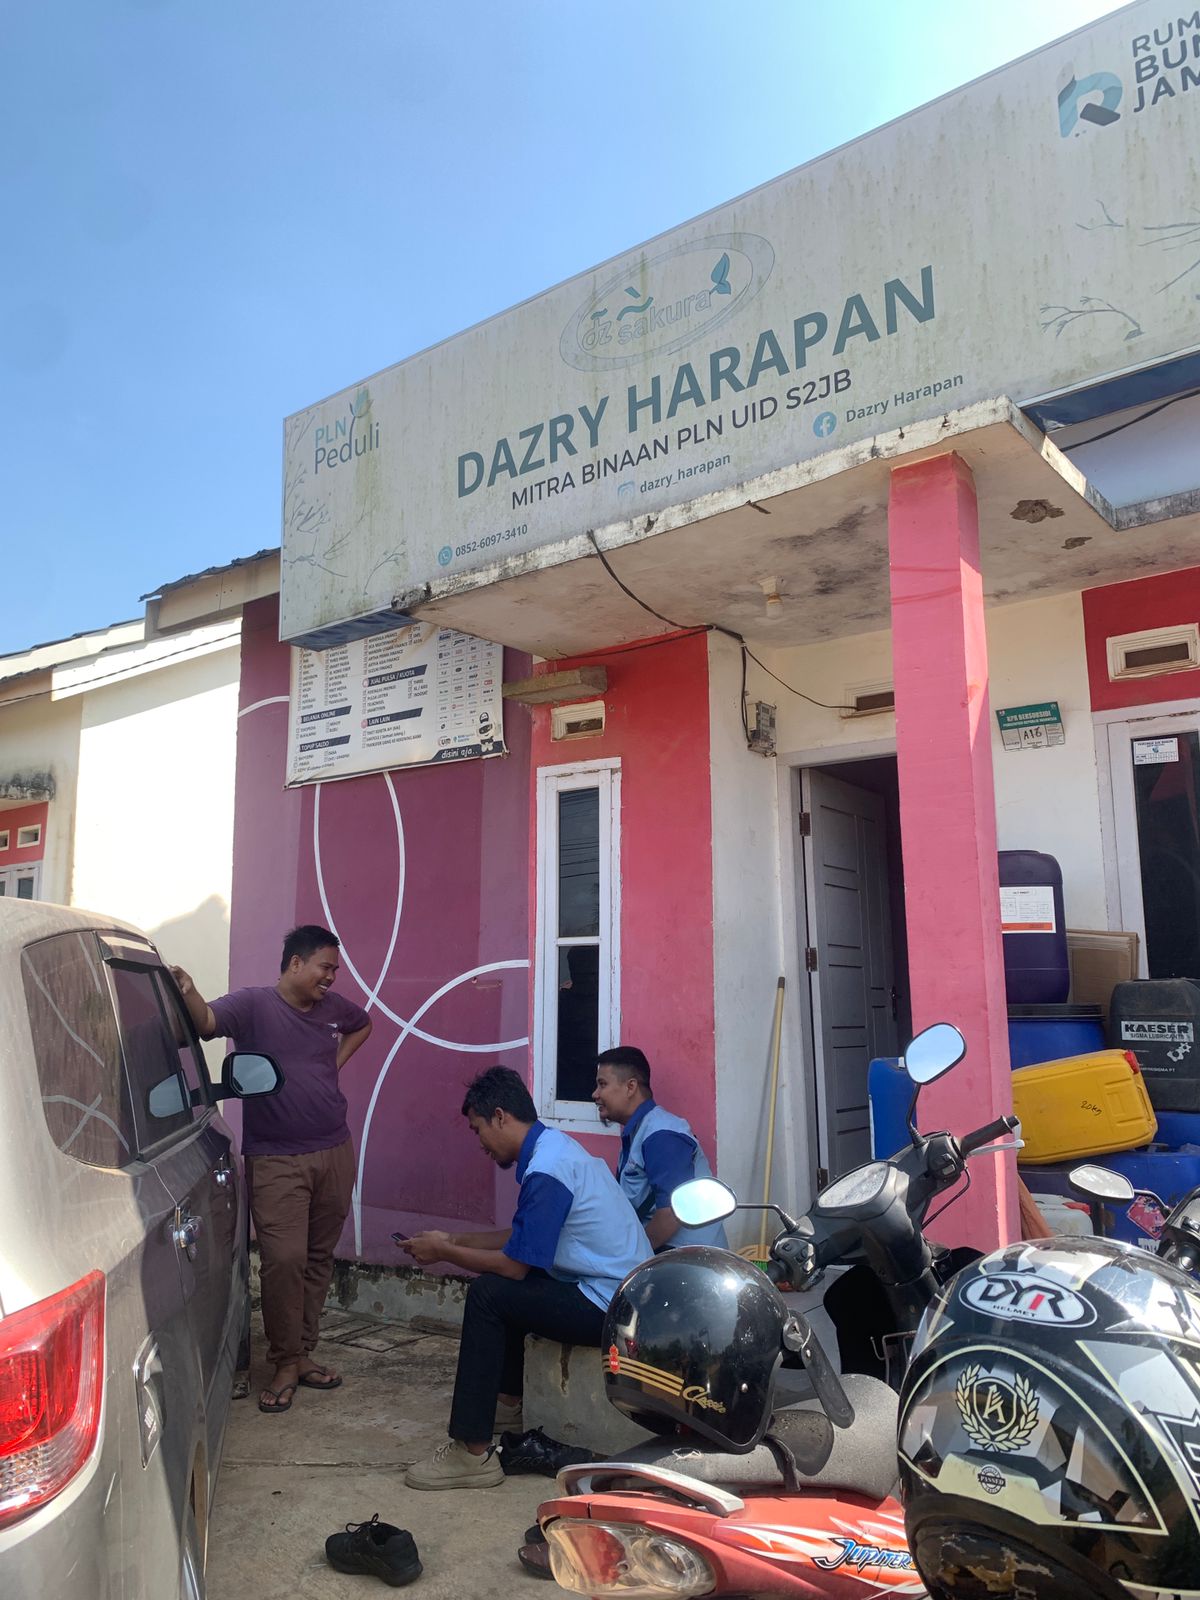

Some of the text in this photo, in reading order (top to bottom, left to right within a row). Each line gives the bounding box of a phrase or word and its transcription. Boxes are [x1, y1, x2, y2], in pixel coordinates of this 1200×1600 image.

[618, 289, 712, 345] sakura
[457, 265, 935, 498] DAZRY HARAPAN
[846, 374, 963, 423] Dazry Harapan
[314, 421, 380, 475] Peduli
[315, 416, 347, 449] PLN
[512, 369, 852, 510] MITRA BINAAN PLN UID S2JB
[639, 455, 731, 494] dazry_harapan
[455, 524, 528, 557] 0852-6097-3410
[320, 710, 336, 719] ONLINE
[315, 741, 330, 749] SALDO
[1024, 726, 1042, 740] A16
[441, 748, 459, 759] disini
[1124, 1024, 1189, 1034] KAESER
[979, 1277, 1065, 1319] DYR
[993, 1305, 1037, 1318] HELMET
